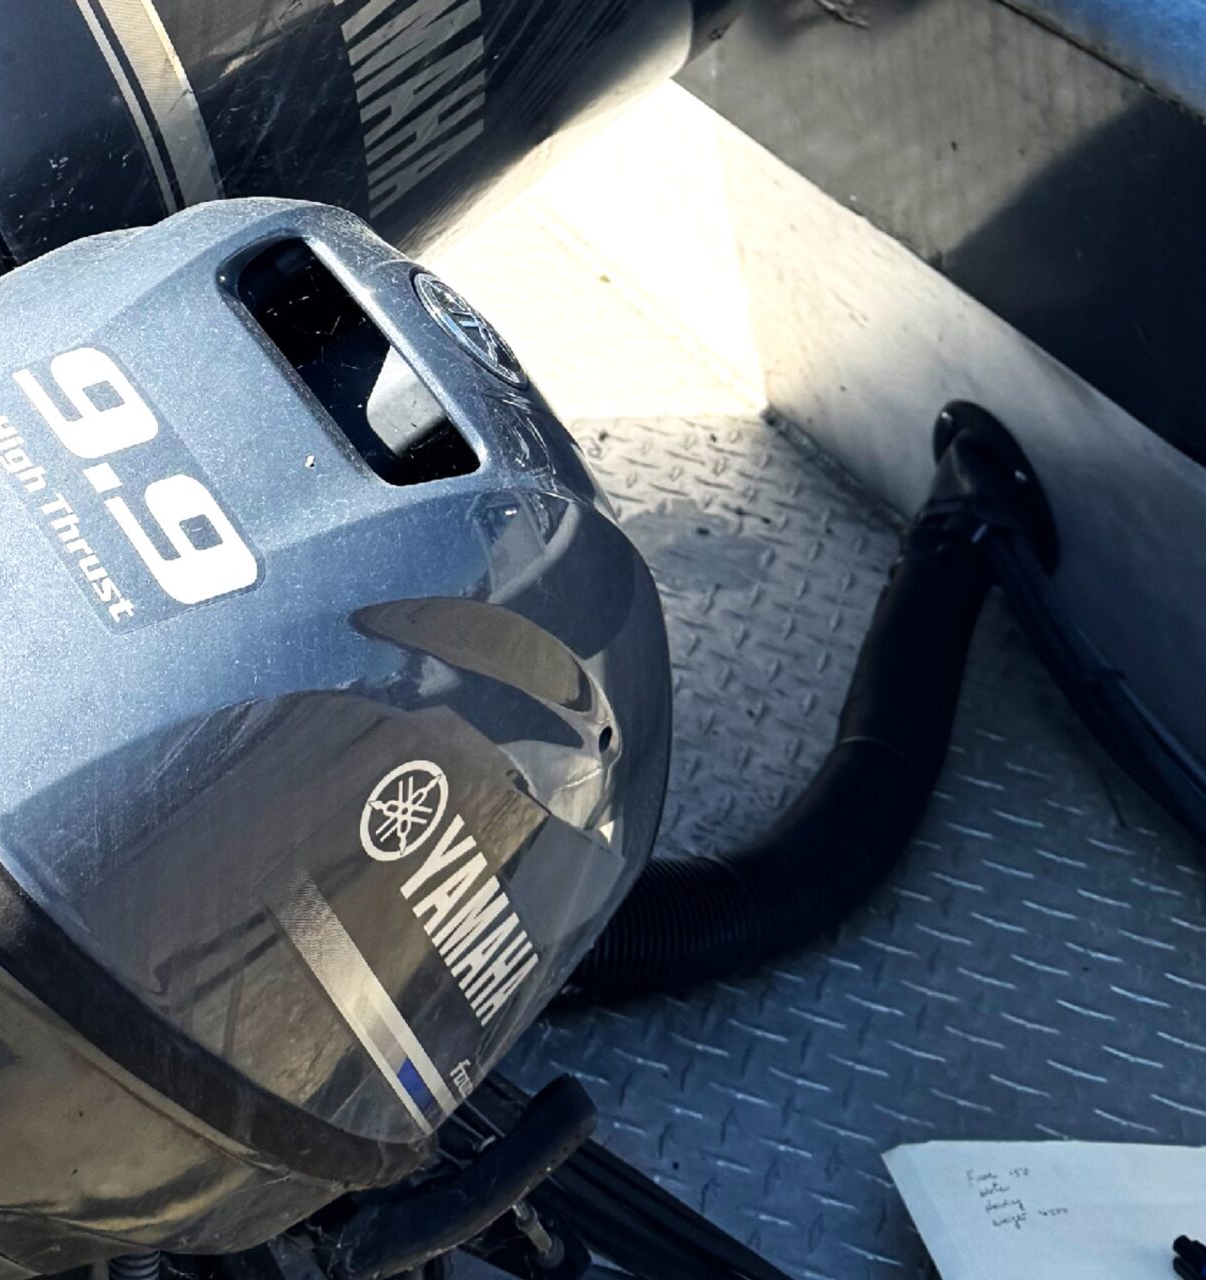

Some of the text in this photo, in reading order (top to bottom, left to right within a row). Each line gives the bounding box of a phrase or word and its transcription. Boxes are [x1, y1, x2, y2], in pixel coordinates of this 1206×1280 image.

[11, 345, 260, 605] 9.9
[39, 489, 135, 623] Thrust
[399, 814, 540, 1028] YAMAHA
